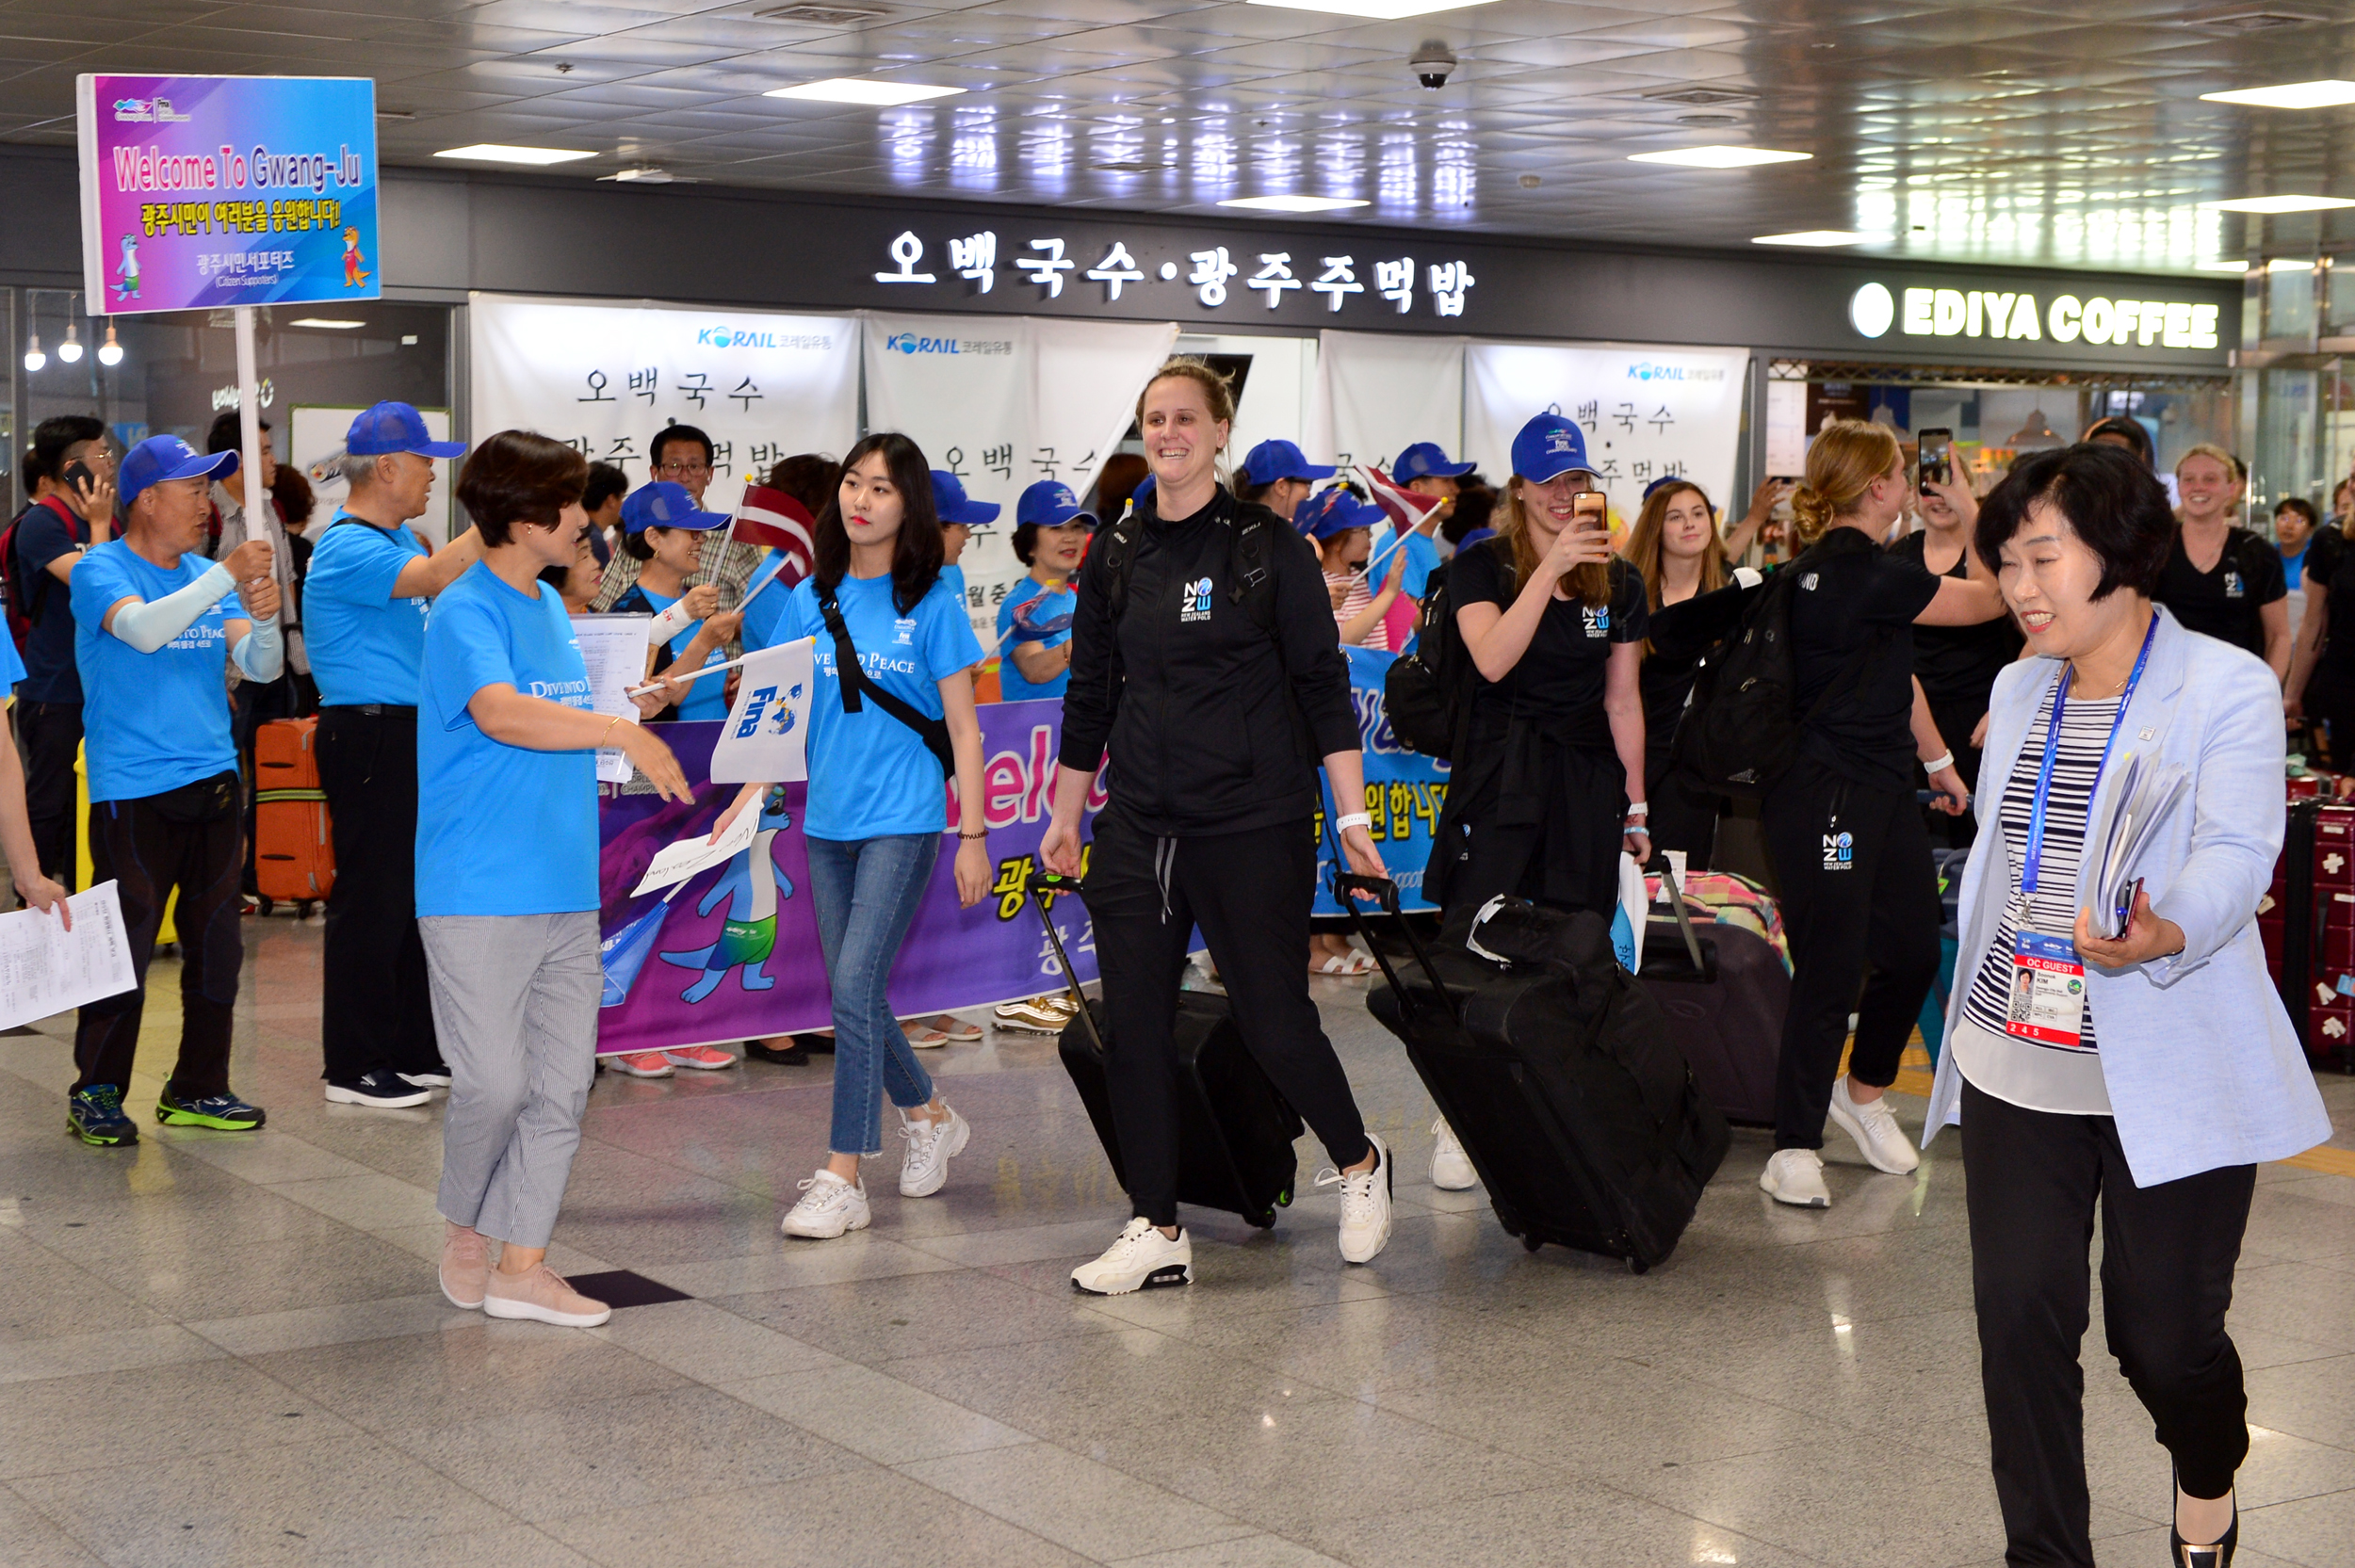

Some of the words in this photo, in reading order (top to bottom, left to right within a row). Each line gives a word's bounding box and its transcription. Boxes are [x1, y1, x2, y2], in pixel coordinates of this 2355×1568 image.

[113, 145, 217, 192] Welcome
[219, 145, 247, 189] To
[252, 143, 362, 194] Gwang-Ju
[141, 202, 210, 236] 광주시민이
[214, 200, 268, 233] 여러분을
[271, 199, 341, 232] 응원합니다!
[196, 251, 295, 275] 광주시민서포터즈
[1902, 287, 2041, 341] EDIYA
[2048, 295, 2220, 349] COFFEE
[200, 625, 226, 639] PEAC
[869, 653, 916, 673] PEACE
[736, 686, 778, 739] Fina
[2026, 958, 2041, 968] OC
[2042, 962, 2074, 974] GUEST
[2010, 1024, 2016, 1032] 2
[2022, 1026, 2027, 1034] 4
[2033, 1027, 2039, 1036] 5
